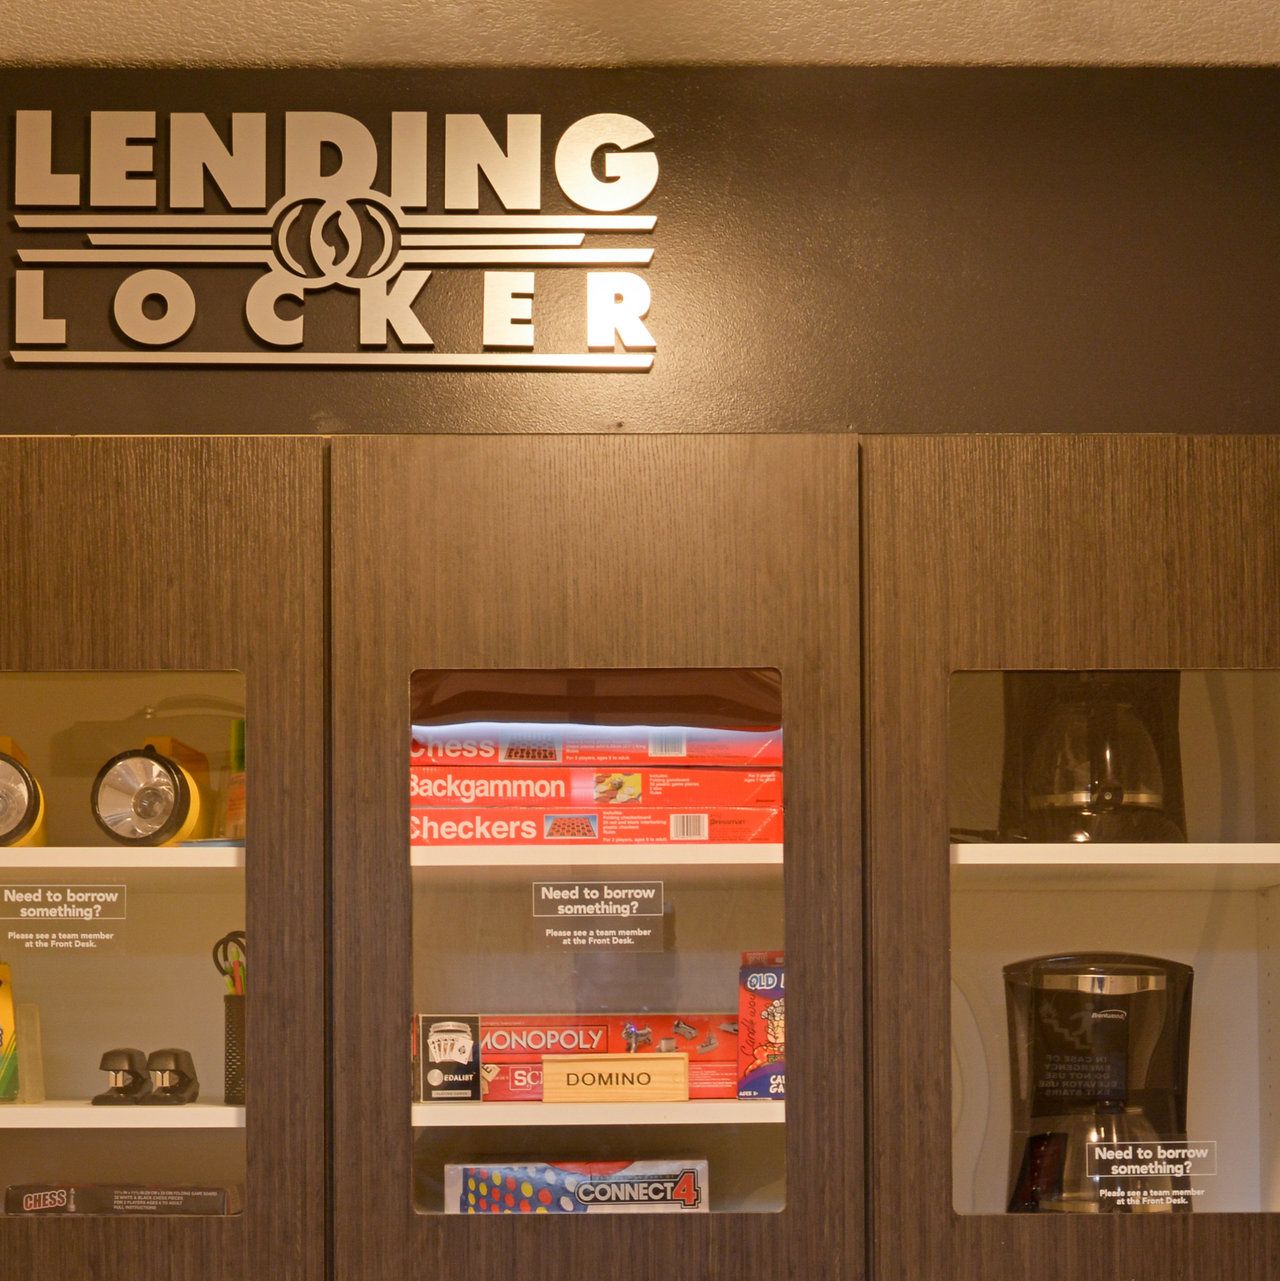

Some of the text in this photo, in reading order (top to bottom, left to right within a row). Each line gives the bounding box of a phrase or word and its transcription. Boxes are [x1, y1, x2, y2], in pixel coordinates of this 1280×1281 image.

[15, 109, 660, 213] LENDING
[15, 269, 656, 352] LOCKER
[4, 889, 118, 902] Need to borrow
[541, 886, 655, 899] Need to borrow
[20, 904, 101, 920] something?
[558, 901, 638, 917] something?
[748, 974, 777, 989] OLD
[567, 1072, 651, 1086] DOMINO
[1095, 1146, 1208, 1159] Need to borrow
[1112, 1161, 1192, 1177] something?
[579, 1173, 697, 1205] CONNECT 4
[1100, 1189, 1125, 1197] Please
[23, 1190, 66, 1210] CHESS
